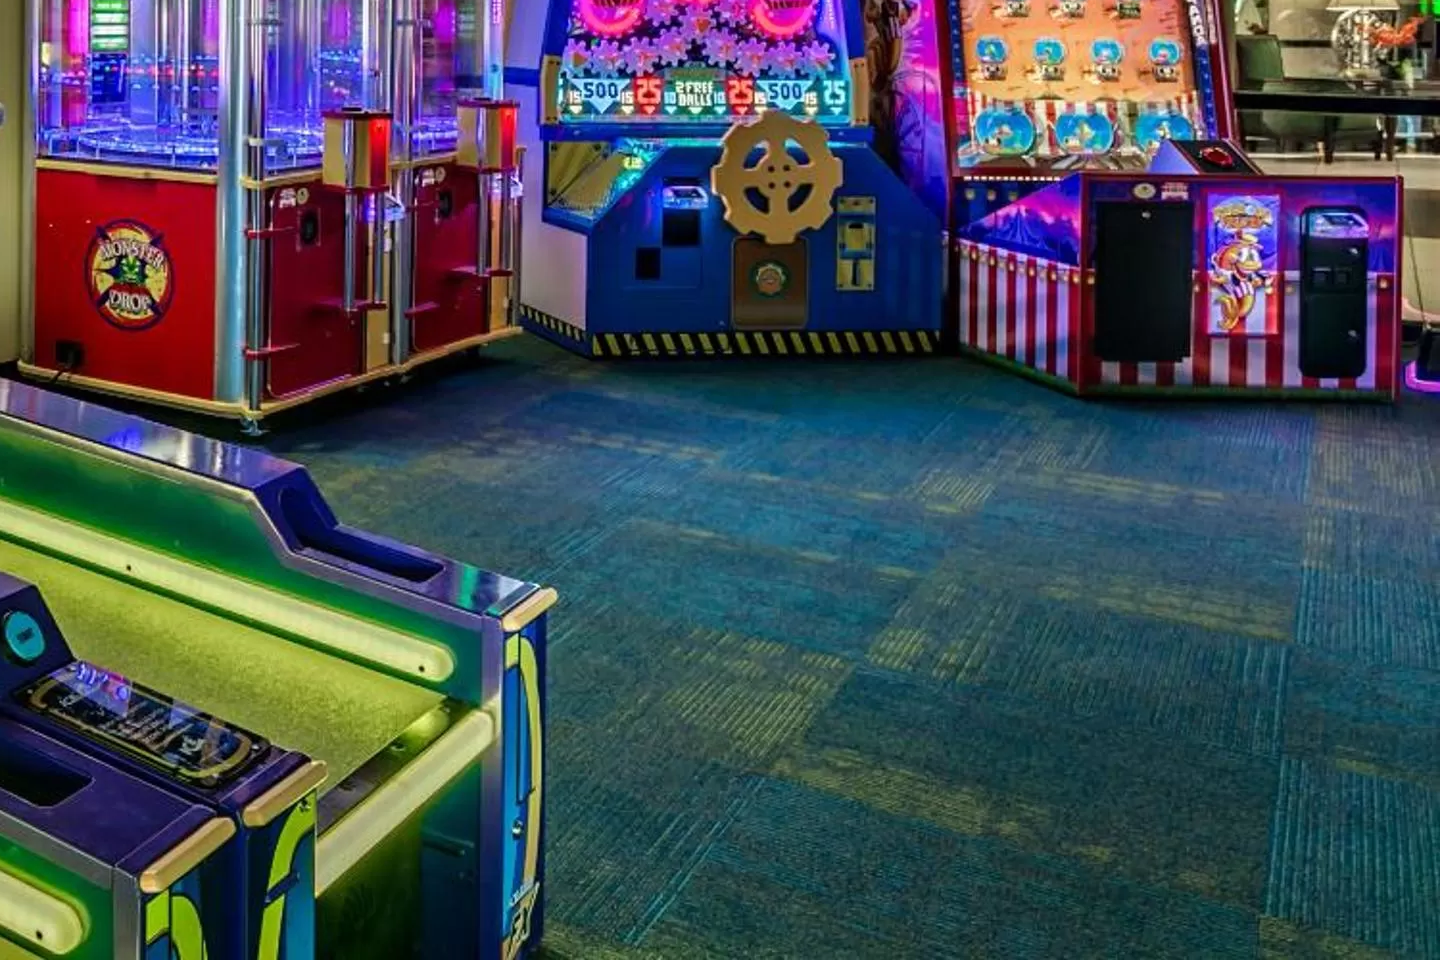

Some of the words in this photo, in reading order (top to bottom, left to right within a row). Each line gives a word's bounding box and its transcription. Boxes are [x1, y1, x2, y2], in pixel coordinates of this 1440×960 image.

[583, 82, 619, 98] 500
[636, 80, 661, 105] 25
[728, 80, 754, 104] 25
[768, 83, 802, 99] 500
[100, 238, 164, 269] MONSTER
